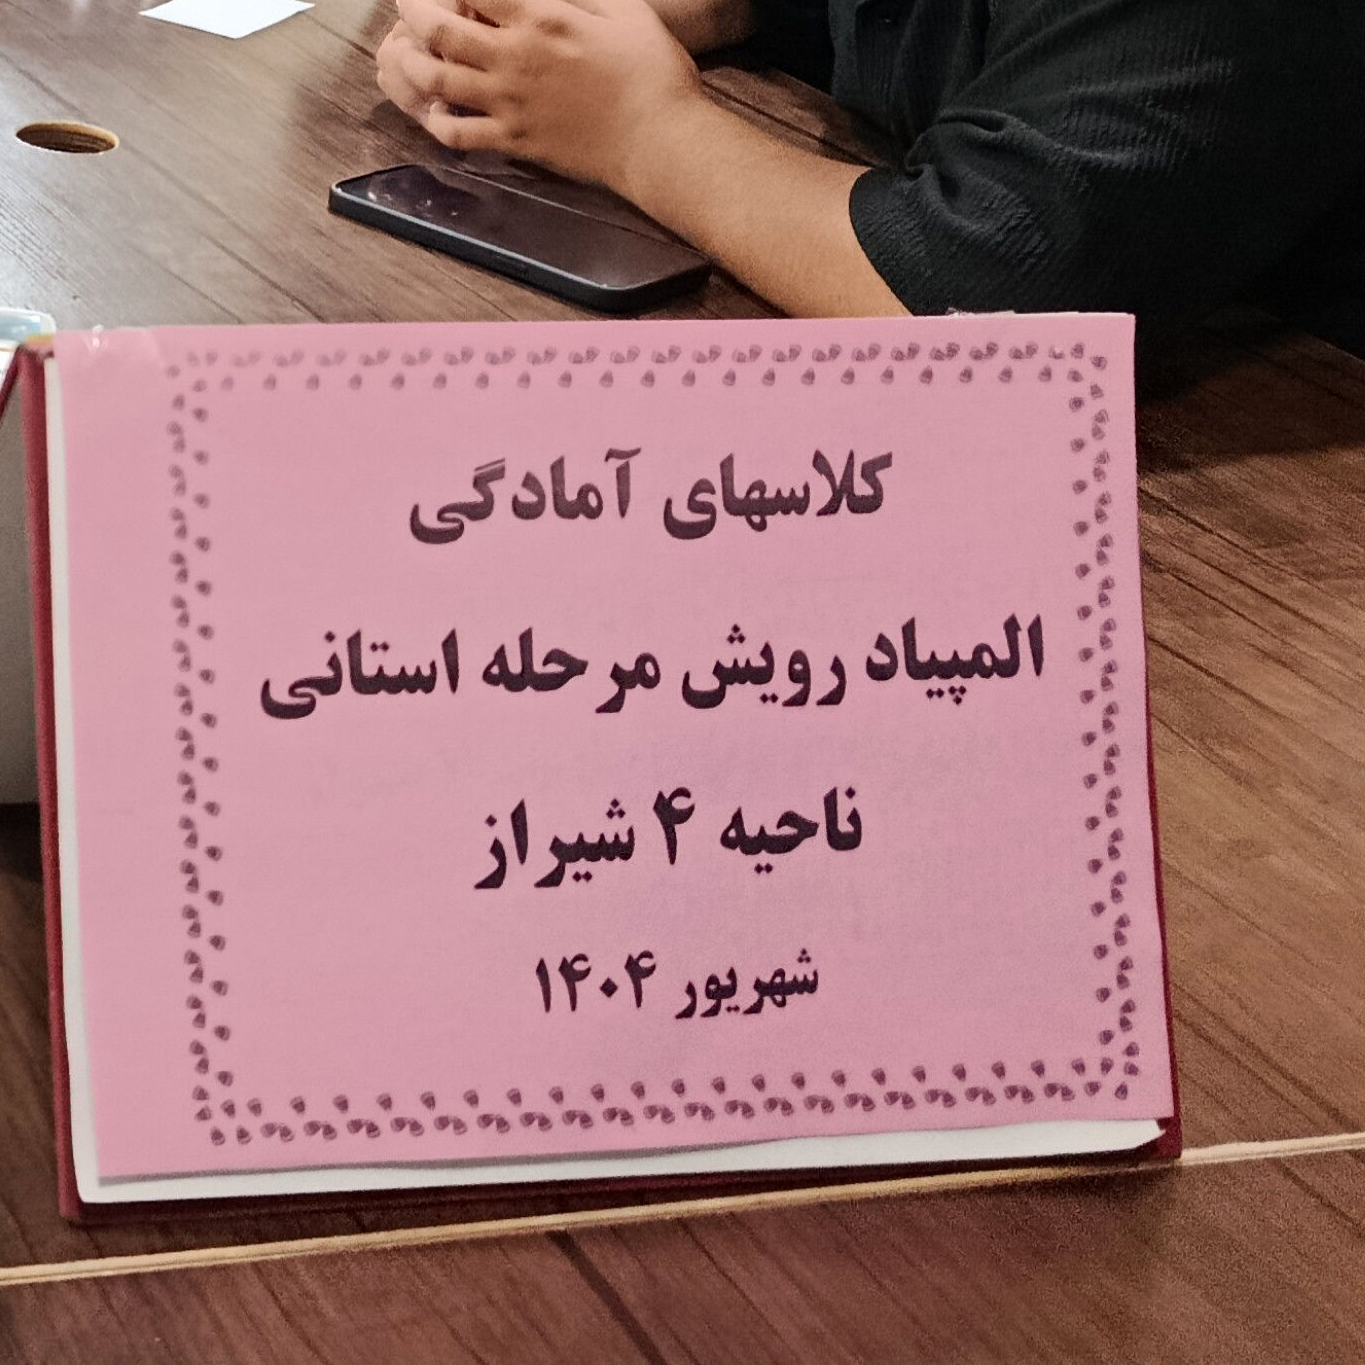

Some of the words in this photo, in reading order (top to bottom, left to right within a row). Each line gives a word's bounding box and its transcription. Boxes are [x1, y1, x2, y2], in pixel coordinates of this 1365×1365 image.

[408, 447, 642, 545] آمادگی
[662, 450, 893, 542] کلاسهای
[259, 627, 461, 720] استانی
[480, 629, 662, 715] مرحله
[680, 622, 847, 710] رویش
[865, 613, 1045, 707] المپیاد
[472, 797, 637, 890] شیراز
[652, 785, 696, 866] ۴
[718, 786, 864, 876] ناحیه
[533, 949, 658, 1014] ۱۴۰۴
[673, 947, 820, 1020] شهریور
